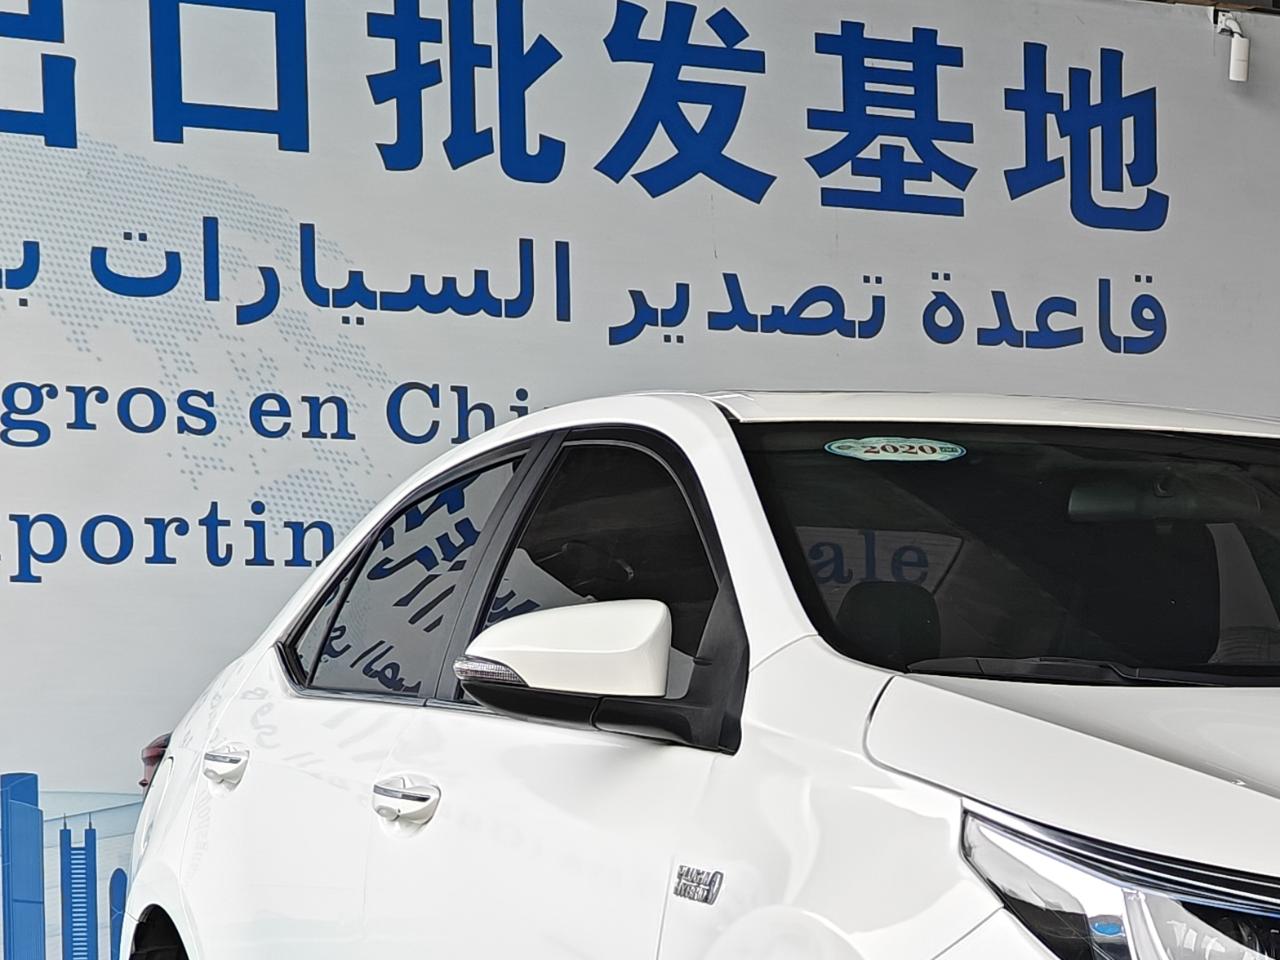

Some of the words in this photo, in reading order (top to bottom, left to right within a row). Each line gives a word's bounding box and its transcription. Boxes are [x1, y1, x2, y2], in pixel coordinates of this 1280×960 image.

[90, 216, 571, 325] السيارات
[608, 272, 886, 346] تصدير
[922, 272, 1168, 355] قاعدة
[0, 381, 217, 447] gros
[250, 388, 356, 440] en
[386, 381, 549, 444] Chi
[862, 443, 938, 455] 2020
[0, 501, 335, 583] portin
